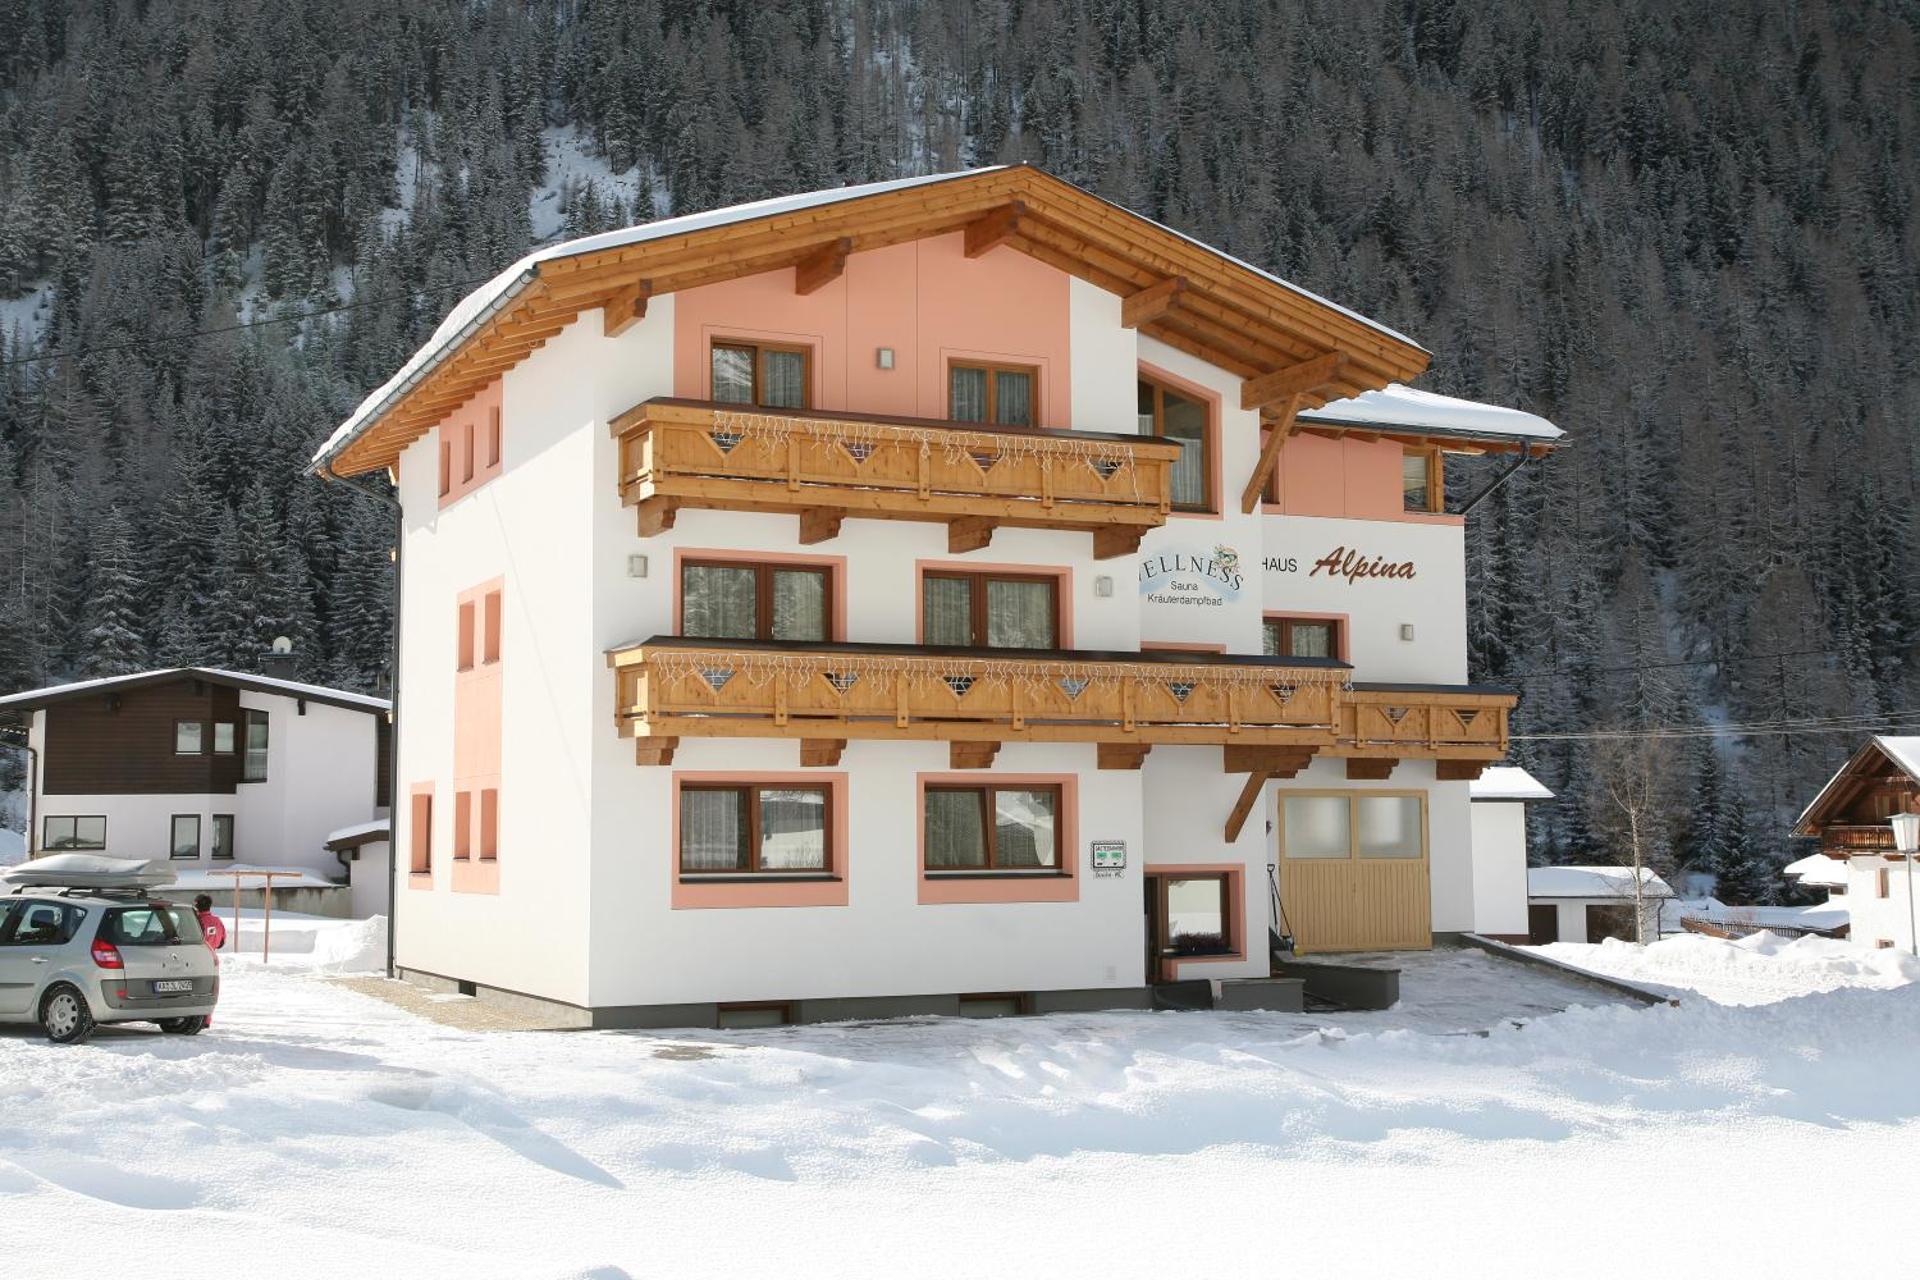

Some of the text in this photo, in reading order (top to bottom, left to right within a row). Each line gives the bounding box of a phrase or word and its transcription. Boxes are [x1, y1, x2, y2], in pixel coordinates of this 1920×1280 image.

[1309, 546, 1417, 585] Alpina
[1170, 580, 1199, 591] Sauna
[1147, 593, 1224, 607] Kräuterdampfbad
